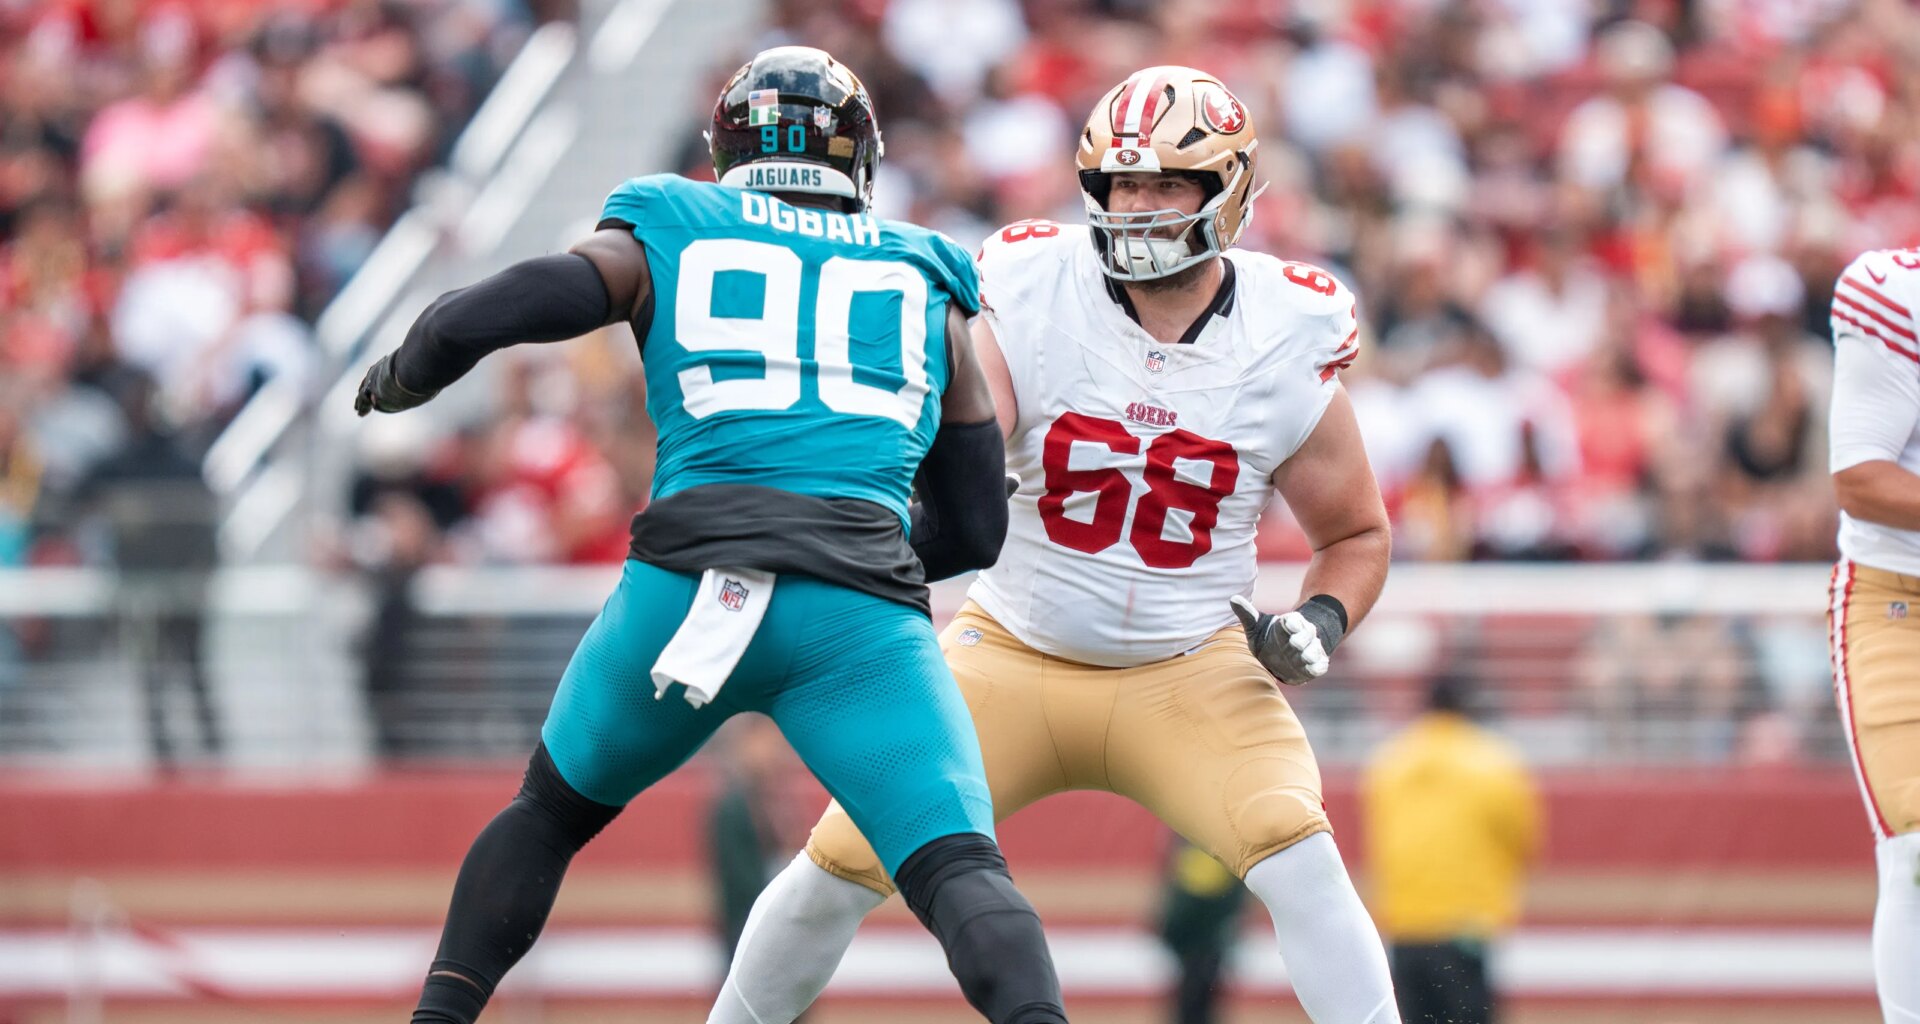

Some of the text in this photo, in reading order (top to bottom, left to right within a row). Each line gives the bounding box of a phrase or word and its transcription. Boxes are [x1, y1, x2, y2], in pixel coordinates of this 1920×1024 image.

[761, 125, 805, 152] 90
[745, 167, 822, 187] JAGUARS
[741, 191, 880, 246] OGBAH
[1283, 260, 1337, 297] 6
[675, 238, 931, 431] 90
[1147, 358, 1163, 371] NFL
[1125, 401, 1178, 427] 49ERS
[1038, 411, 1240, 569] 68
[721, 589, 741, 609] NFL
